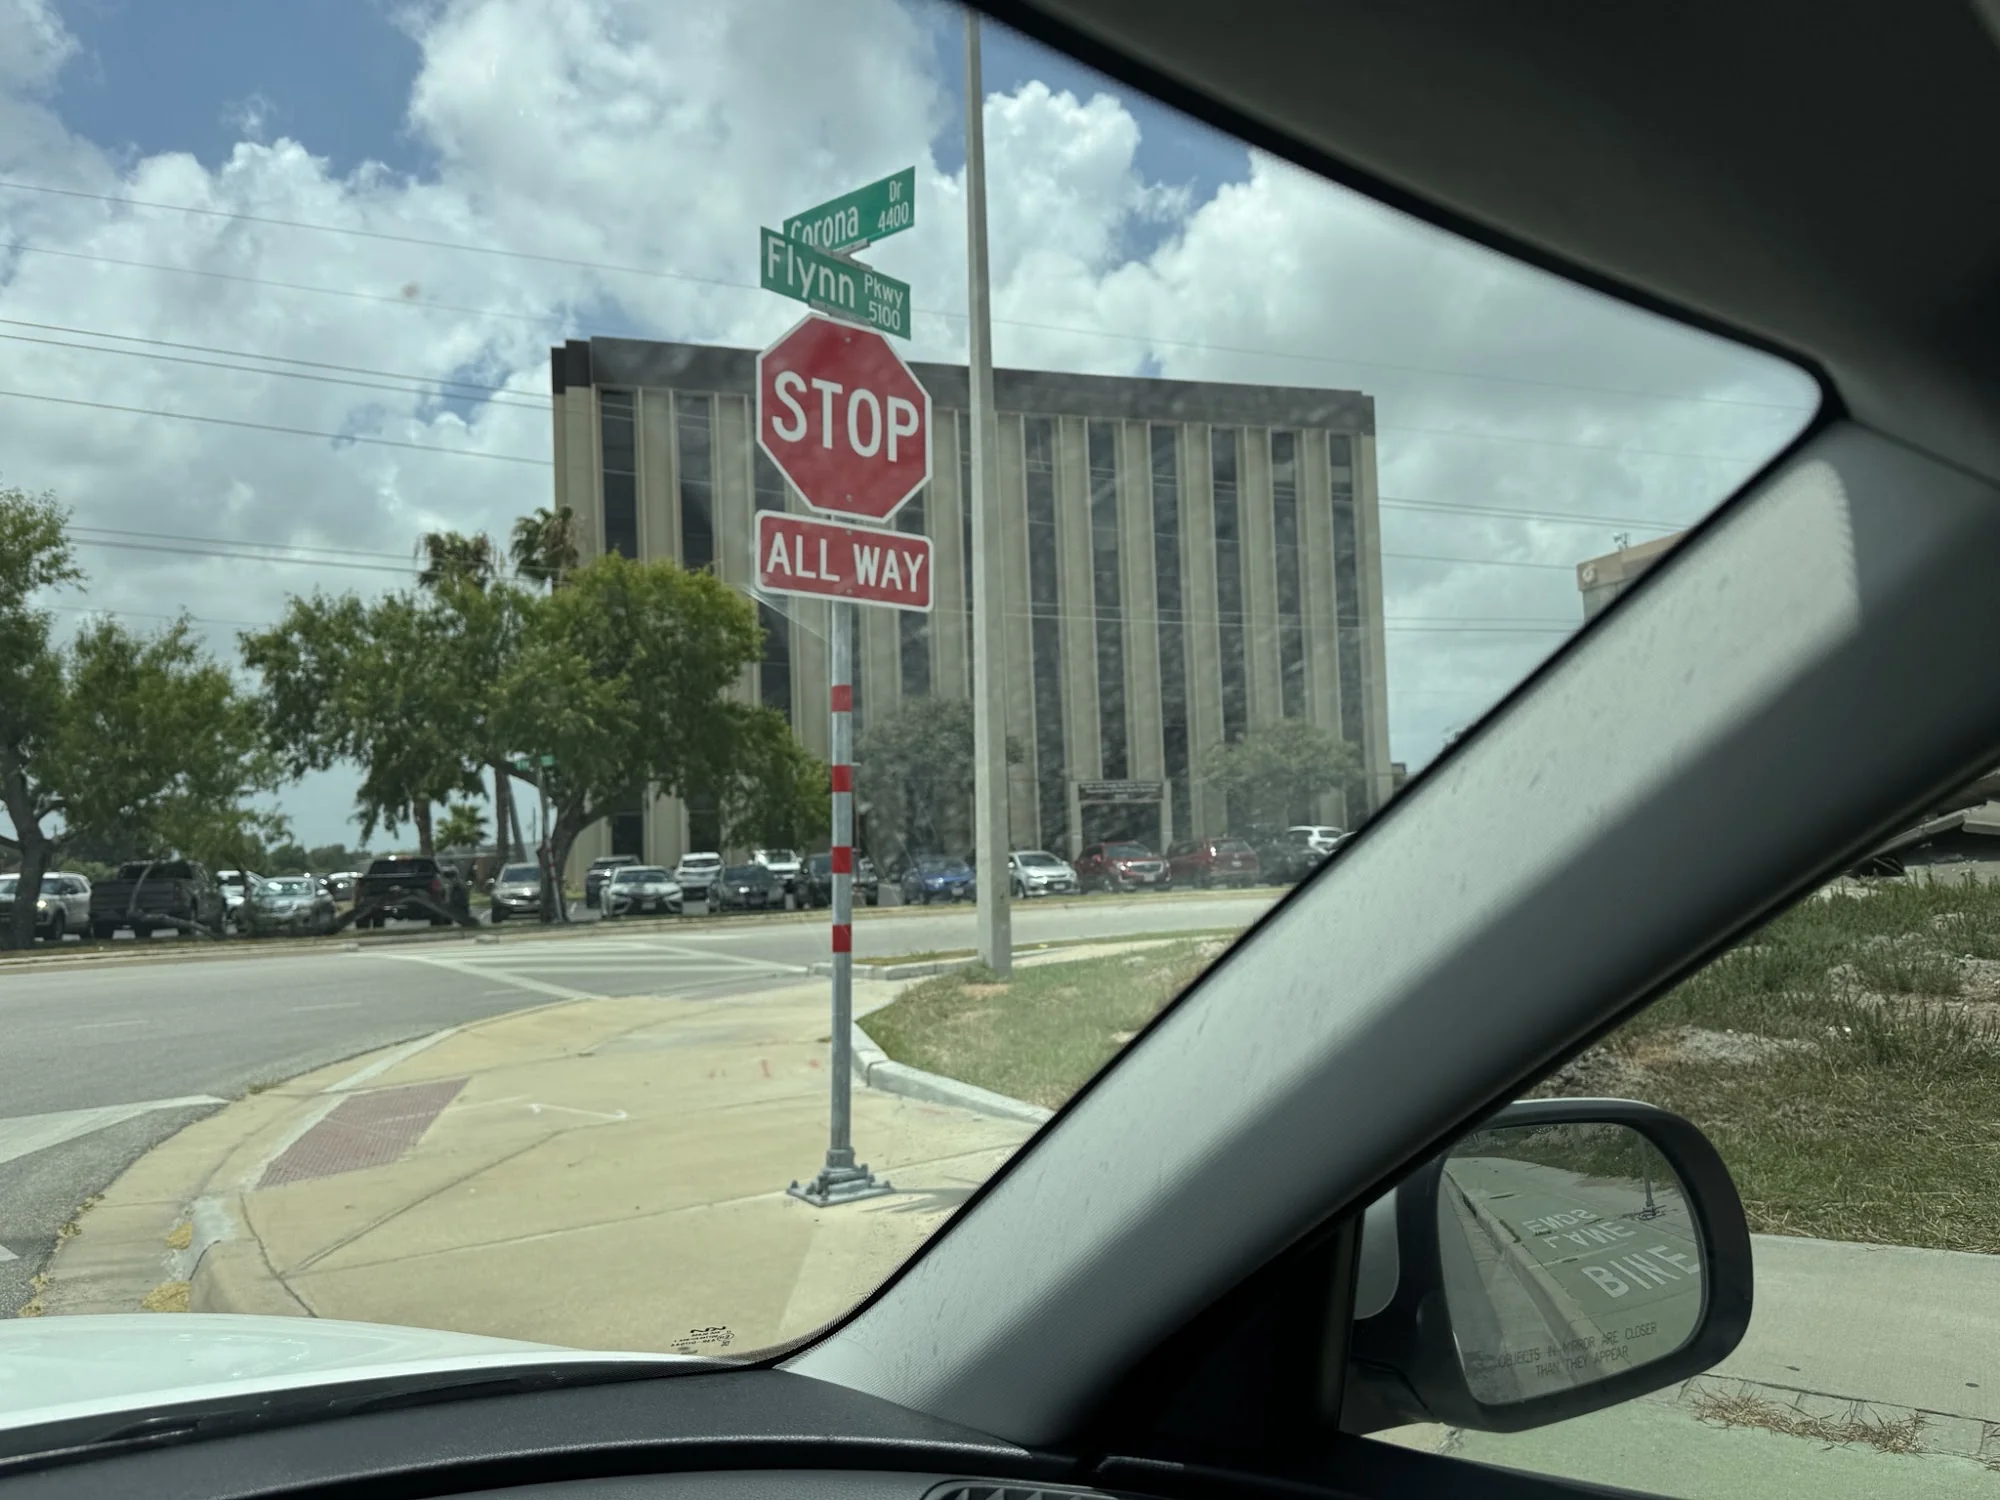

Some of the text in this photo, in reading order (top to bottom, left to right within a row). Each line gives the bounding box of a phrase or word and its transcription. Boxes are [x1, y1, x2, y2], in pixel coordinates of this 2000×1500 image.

[888, 180, 903, 203] Dr
[790, 205, 859, 247] Corona
[878, 201, 910, 232] 4400
[767, 235, 855, 309] Flynn
[864, 273, 904, 310] Pkwy
[868, 301, 901, 330] 5100
[772, 370, 920, 463] STOP
[766, 531, 925, 593] ALL WAY
[1499, 1347, 1541, 1369] OBJECTS
[1561, 1335, 1595, 1355] MIRROR
[1601, 1330, 1619, 1345] ARE
[1625, 1321, 1657, 1341] CLOSER
[1535, 1346, 1629, 1378] THAN THEY APPEAR
